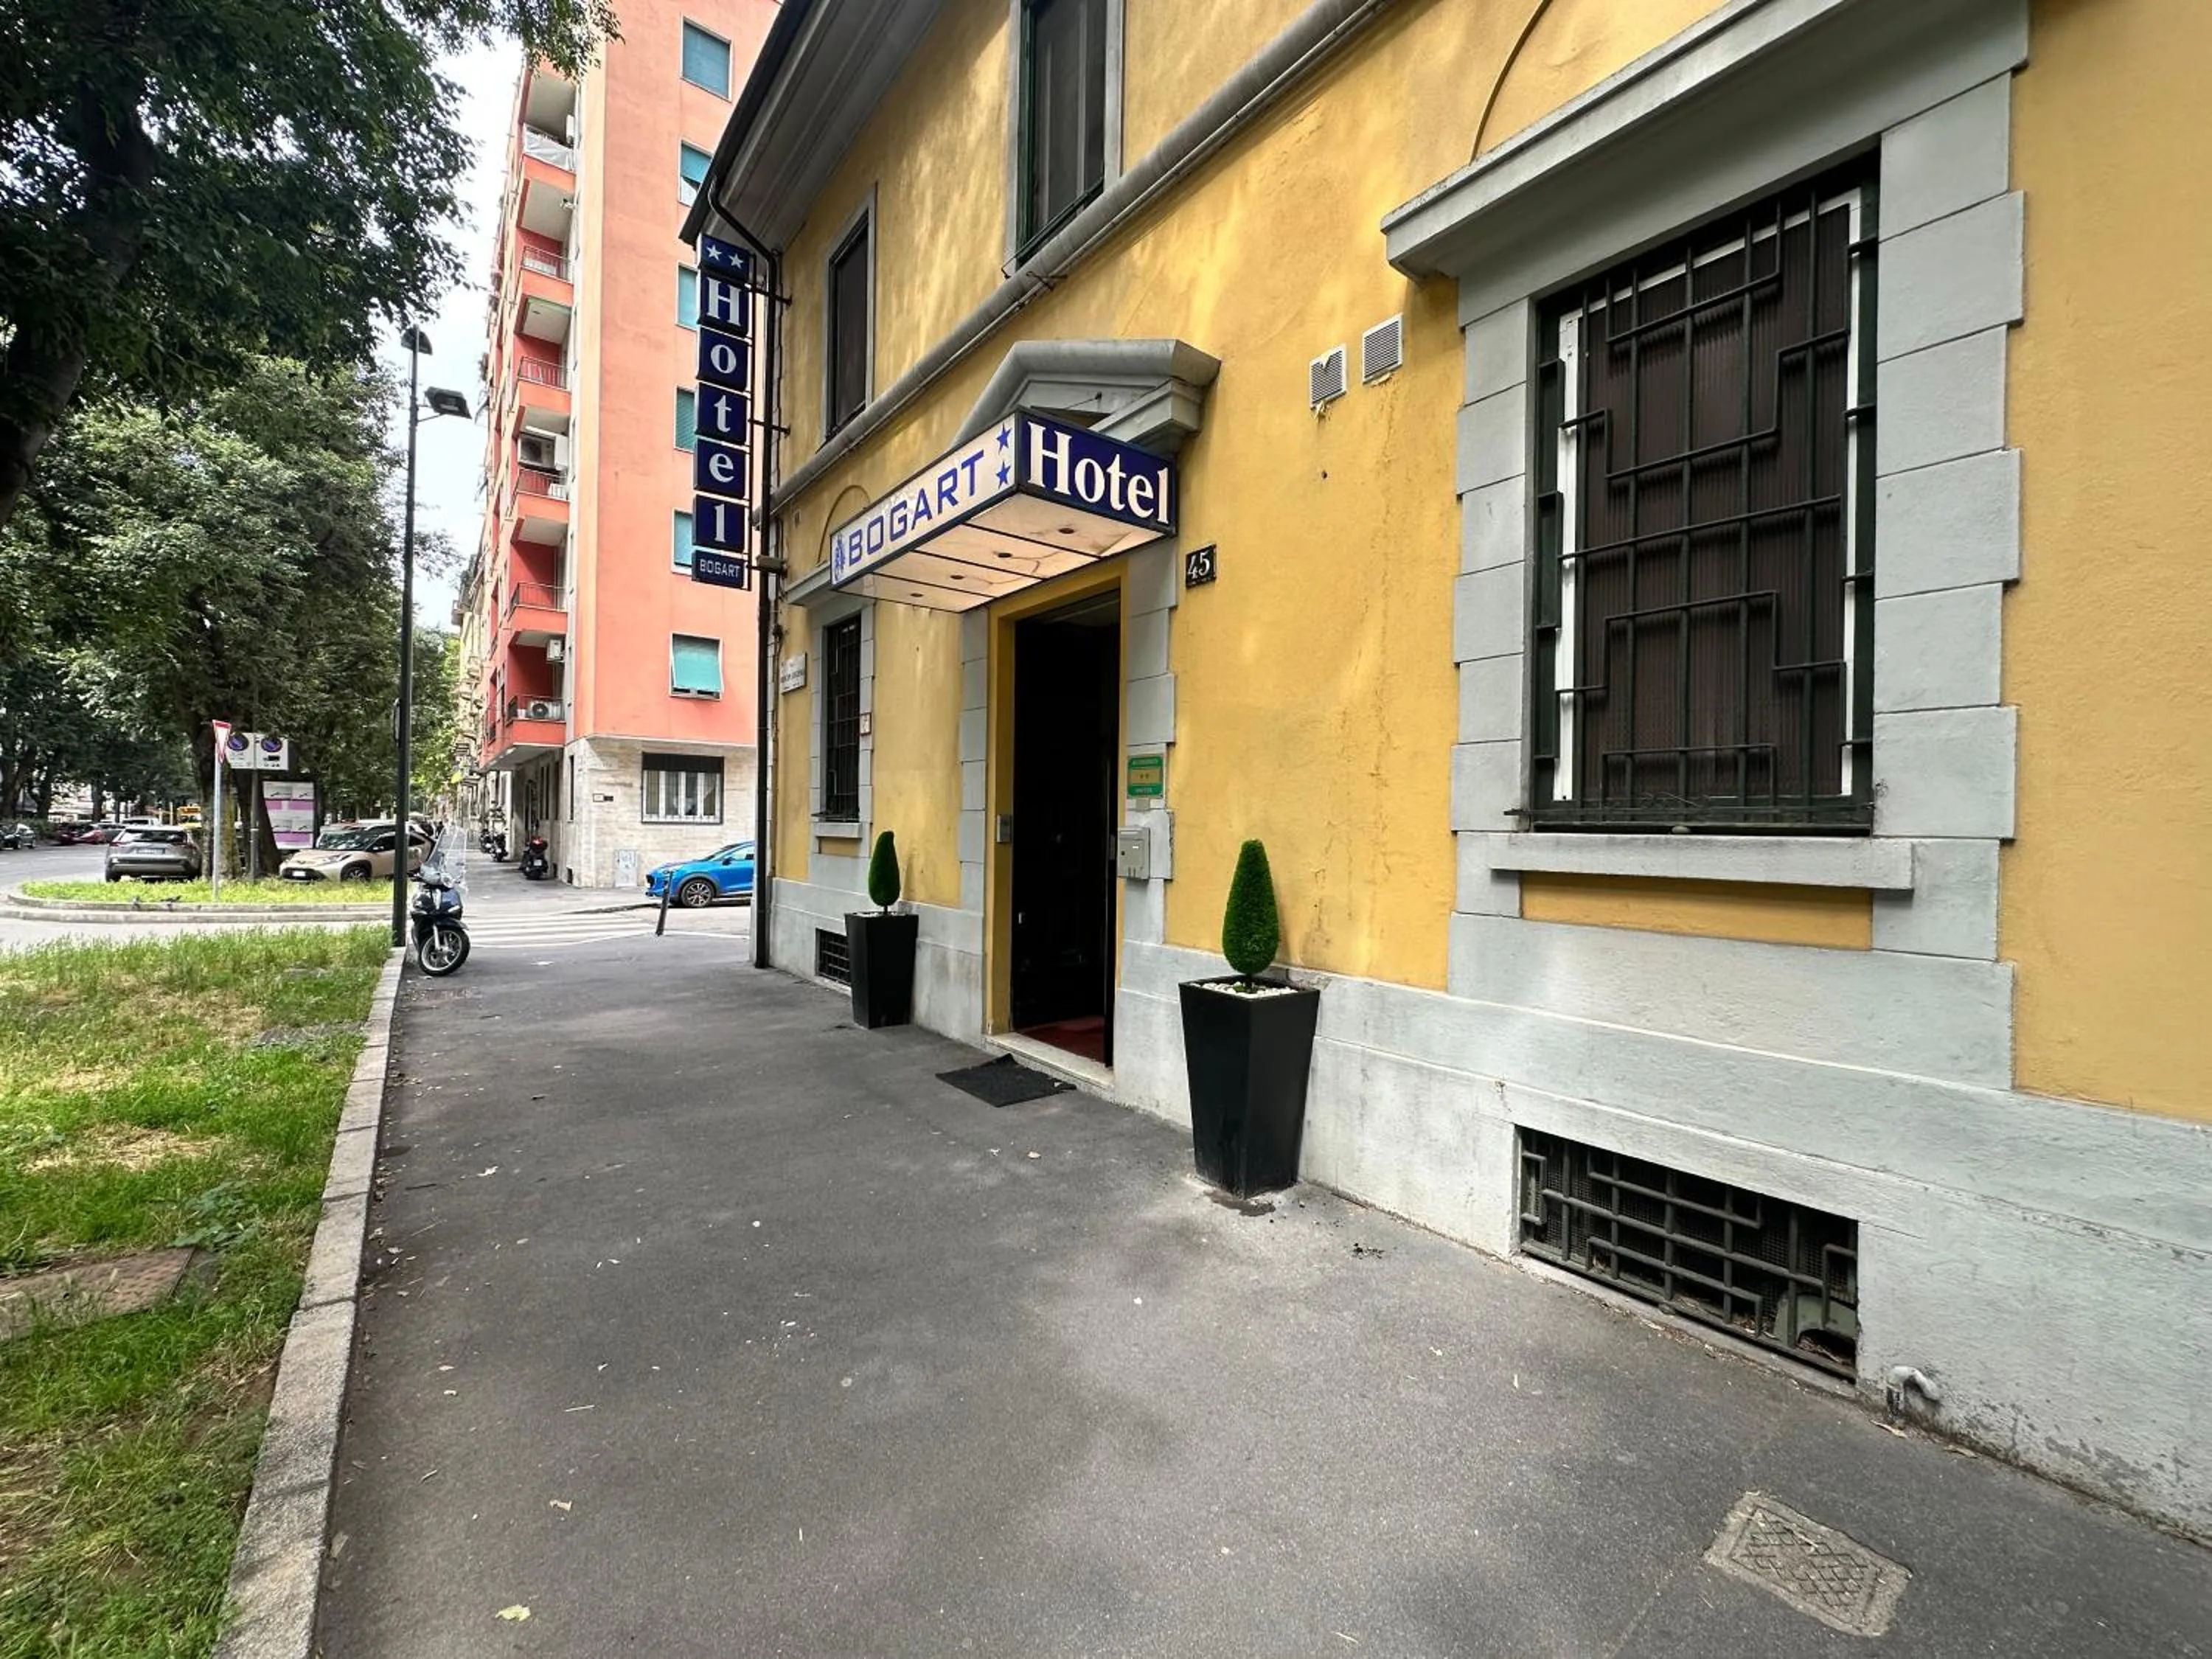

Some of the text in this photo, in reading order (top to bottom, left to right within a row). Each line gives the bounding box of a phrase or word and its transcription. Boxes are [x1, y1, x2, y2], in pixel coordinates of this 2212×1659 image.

[707, 277, 741, 543] Hotel
[848, 449, 984, 566] BOGART
[1026, 421, 1169, 524] Hotel
[700, 558, 740, 578] BOGART
[1188, 549, 1210, 579] 45
